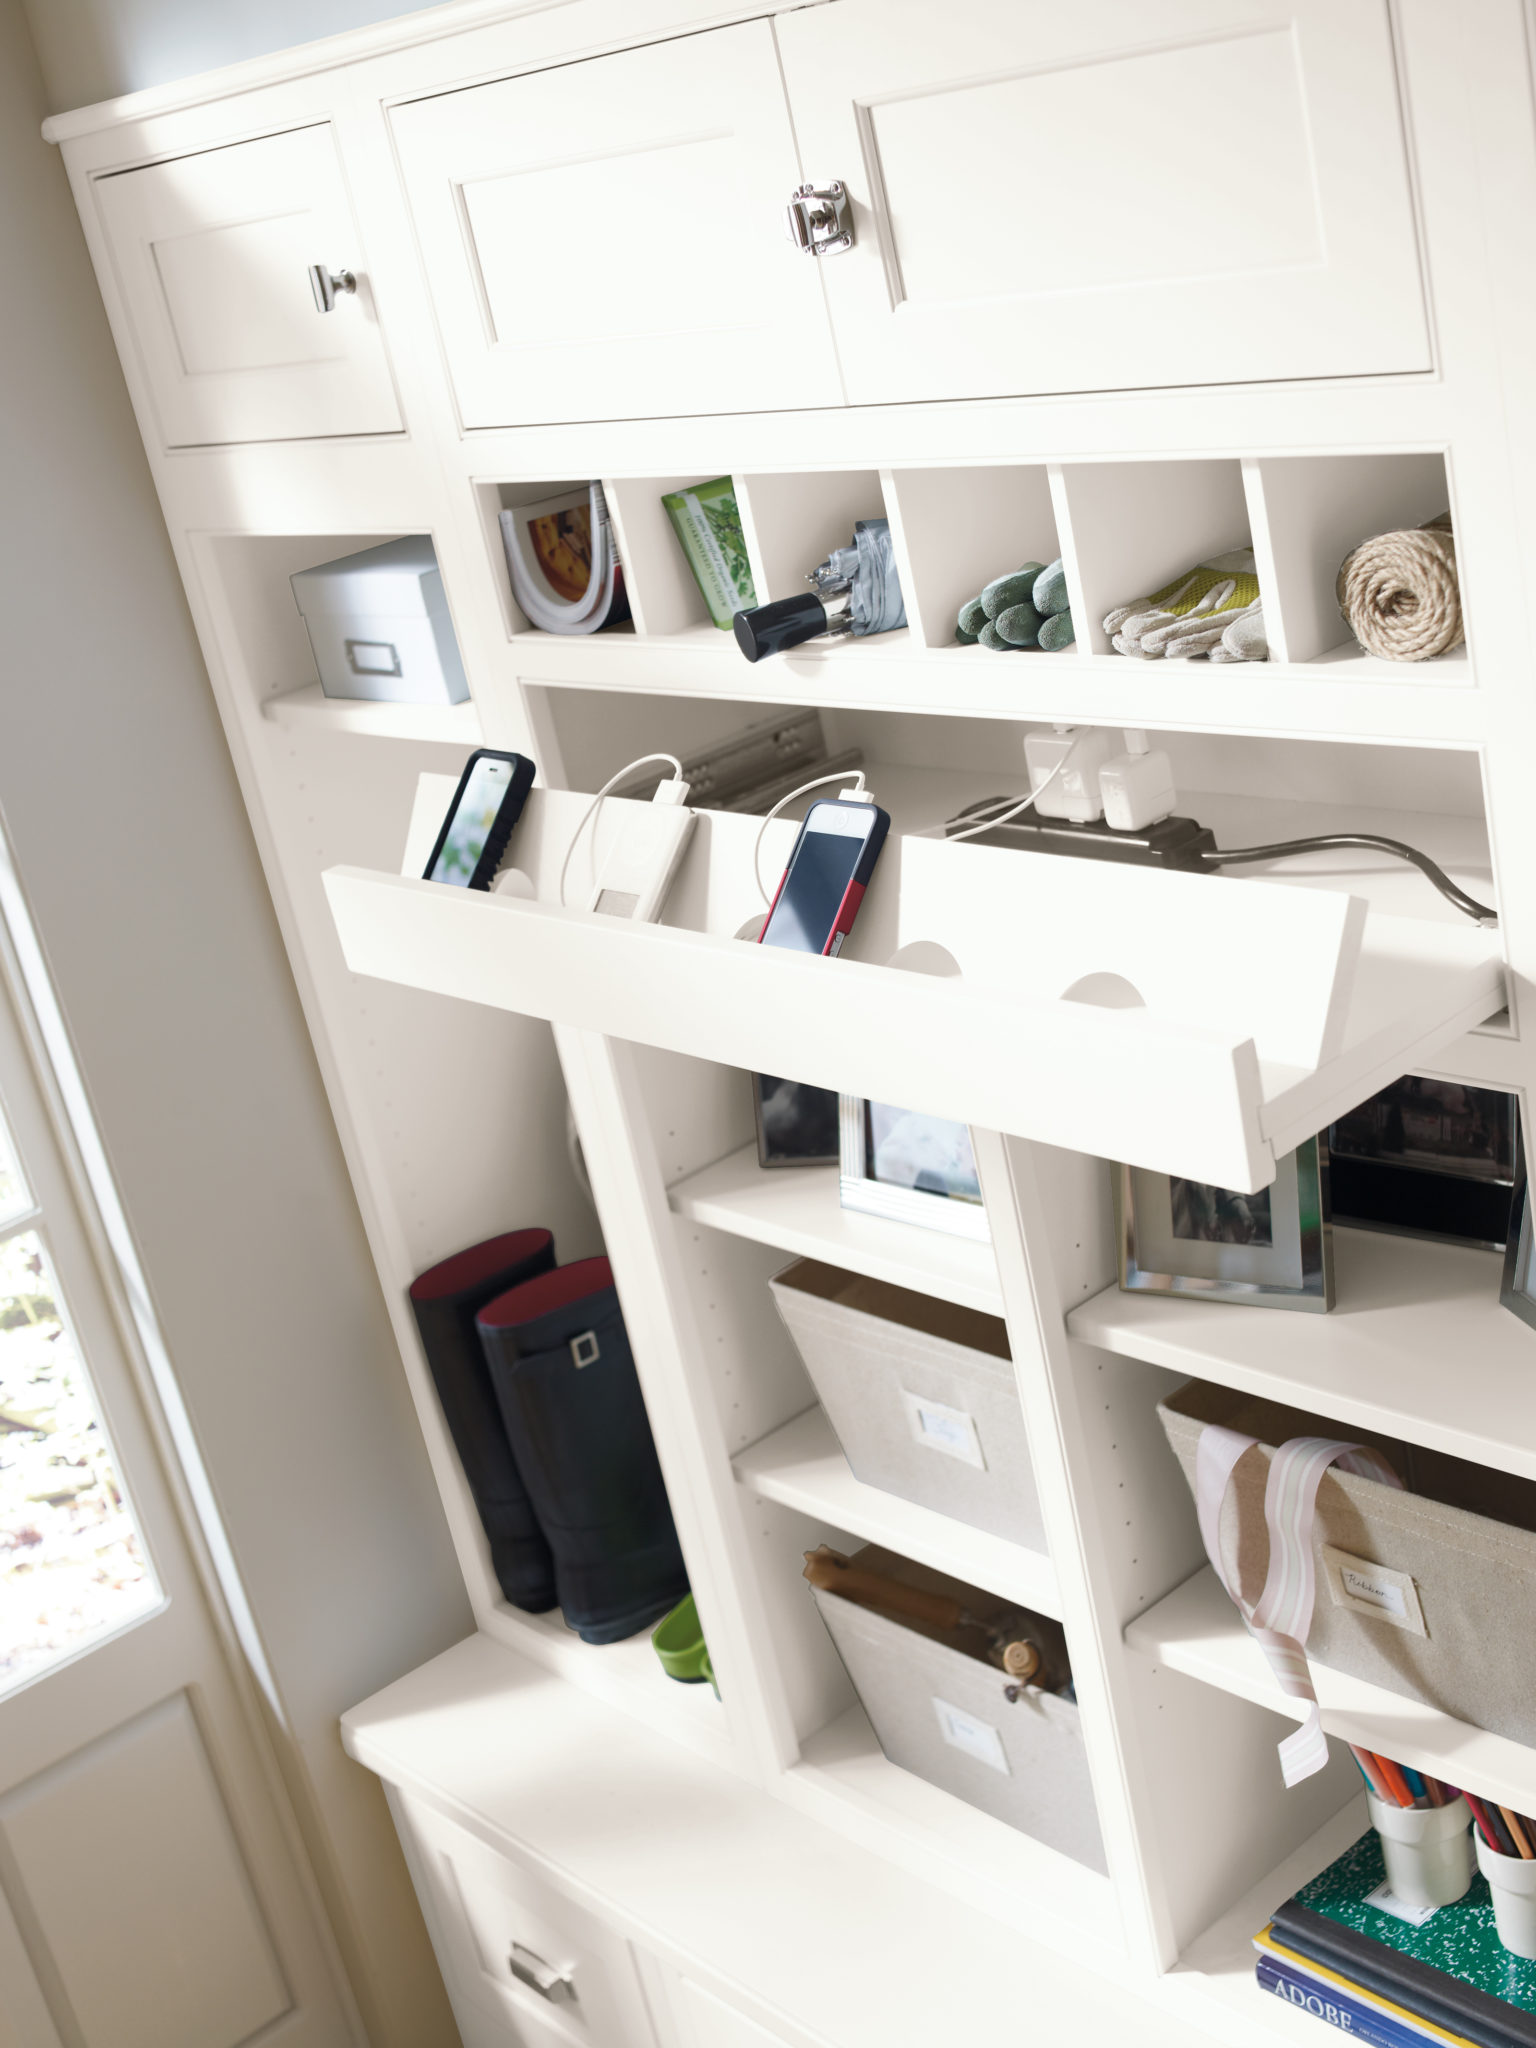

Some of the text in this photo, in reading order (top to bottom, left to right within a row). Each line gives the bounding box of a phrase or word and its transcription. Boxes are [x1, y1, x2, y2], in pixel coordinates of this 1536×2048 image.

[686, 517, 711, 570] GUARANTEED
[713, 584, 727, 607] GROW
[1274, 1979, 1353, 2033] ADOBE
